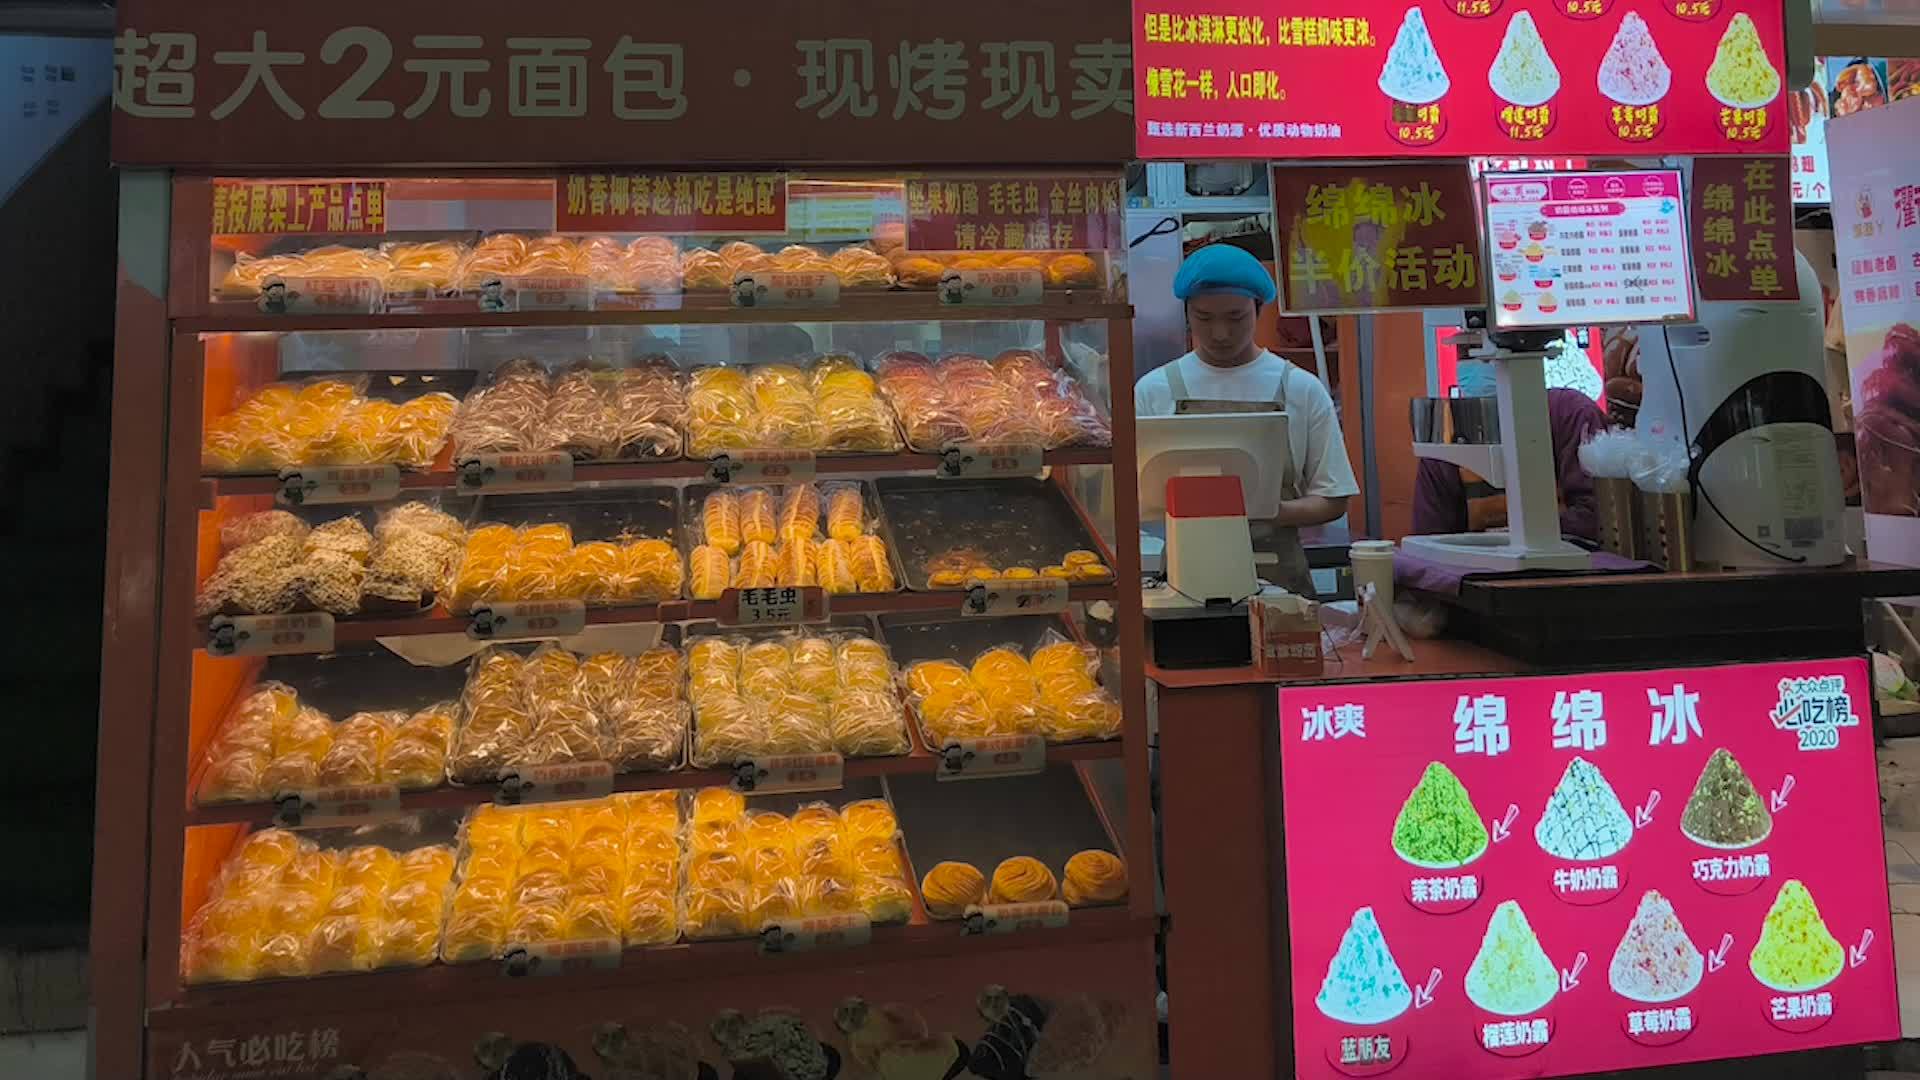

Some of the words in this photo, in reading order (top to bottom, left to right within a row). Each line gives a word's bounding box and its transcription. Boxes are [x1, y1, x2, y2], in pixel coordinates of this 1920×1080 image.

[113, 26, 688, 120] 超大2元面包
[796, 38, 1133, 120] 现烤现卖
[567, 175, 776, 216] 奶香椰蓉趁热吃是绝配
[989, 182, 1040, 215] 毛毛虫
[1305, 181, 1447, 229] 绵绵冰
[955, 223, 1073, 250] 请冷藏保存
[1703, 183, 1739, 278] 绵绵冰
[1743, 160, 1784, 297] 在此点单
[1289, 243, 1476, 294] 半价活动
[742, 588, 796, 605] 毛毛虫
[1794, 678, 1842, 694] 大众点评
[1301, 703, 1367, 741] 冰爽
[1453, 684, 1703, 756] 绵绵冰
[1774, 697, 1849, 725] 必吃榜
[1800, 729, 1837, 748] 2020
[1554, 865, 1618, 893] 牛奶奶霸
[1692, 854, 1770, 881] 巧克力奶霸
[1628, 1007, 1692, 1035] 草莓奶霸
[1770, 992, 1833, 1020] 芒果奶霸
[1482, 1018, 1549, 1048] 榴莲奶霸
[175, 1028, 338, 1072] 人气必吃榜
[1340, 1036, 1391, 1062] 蓝朋友
